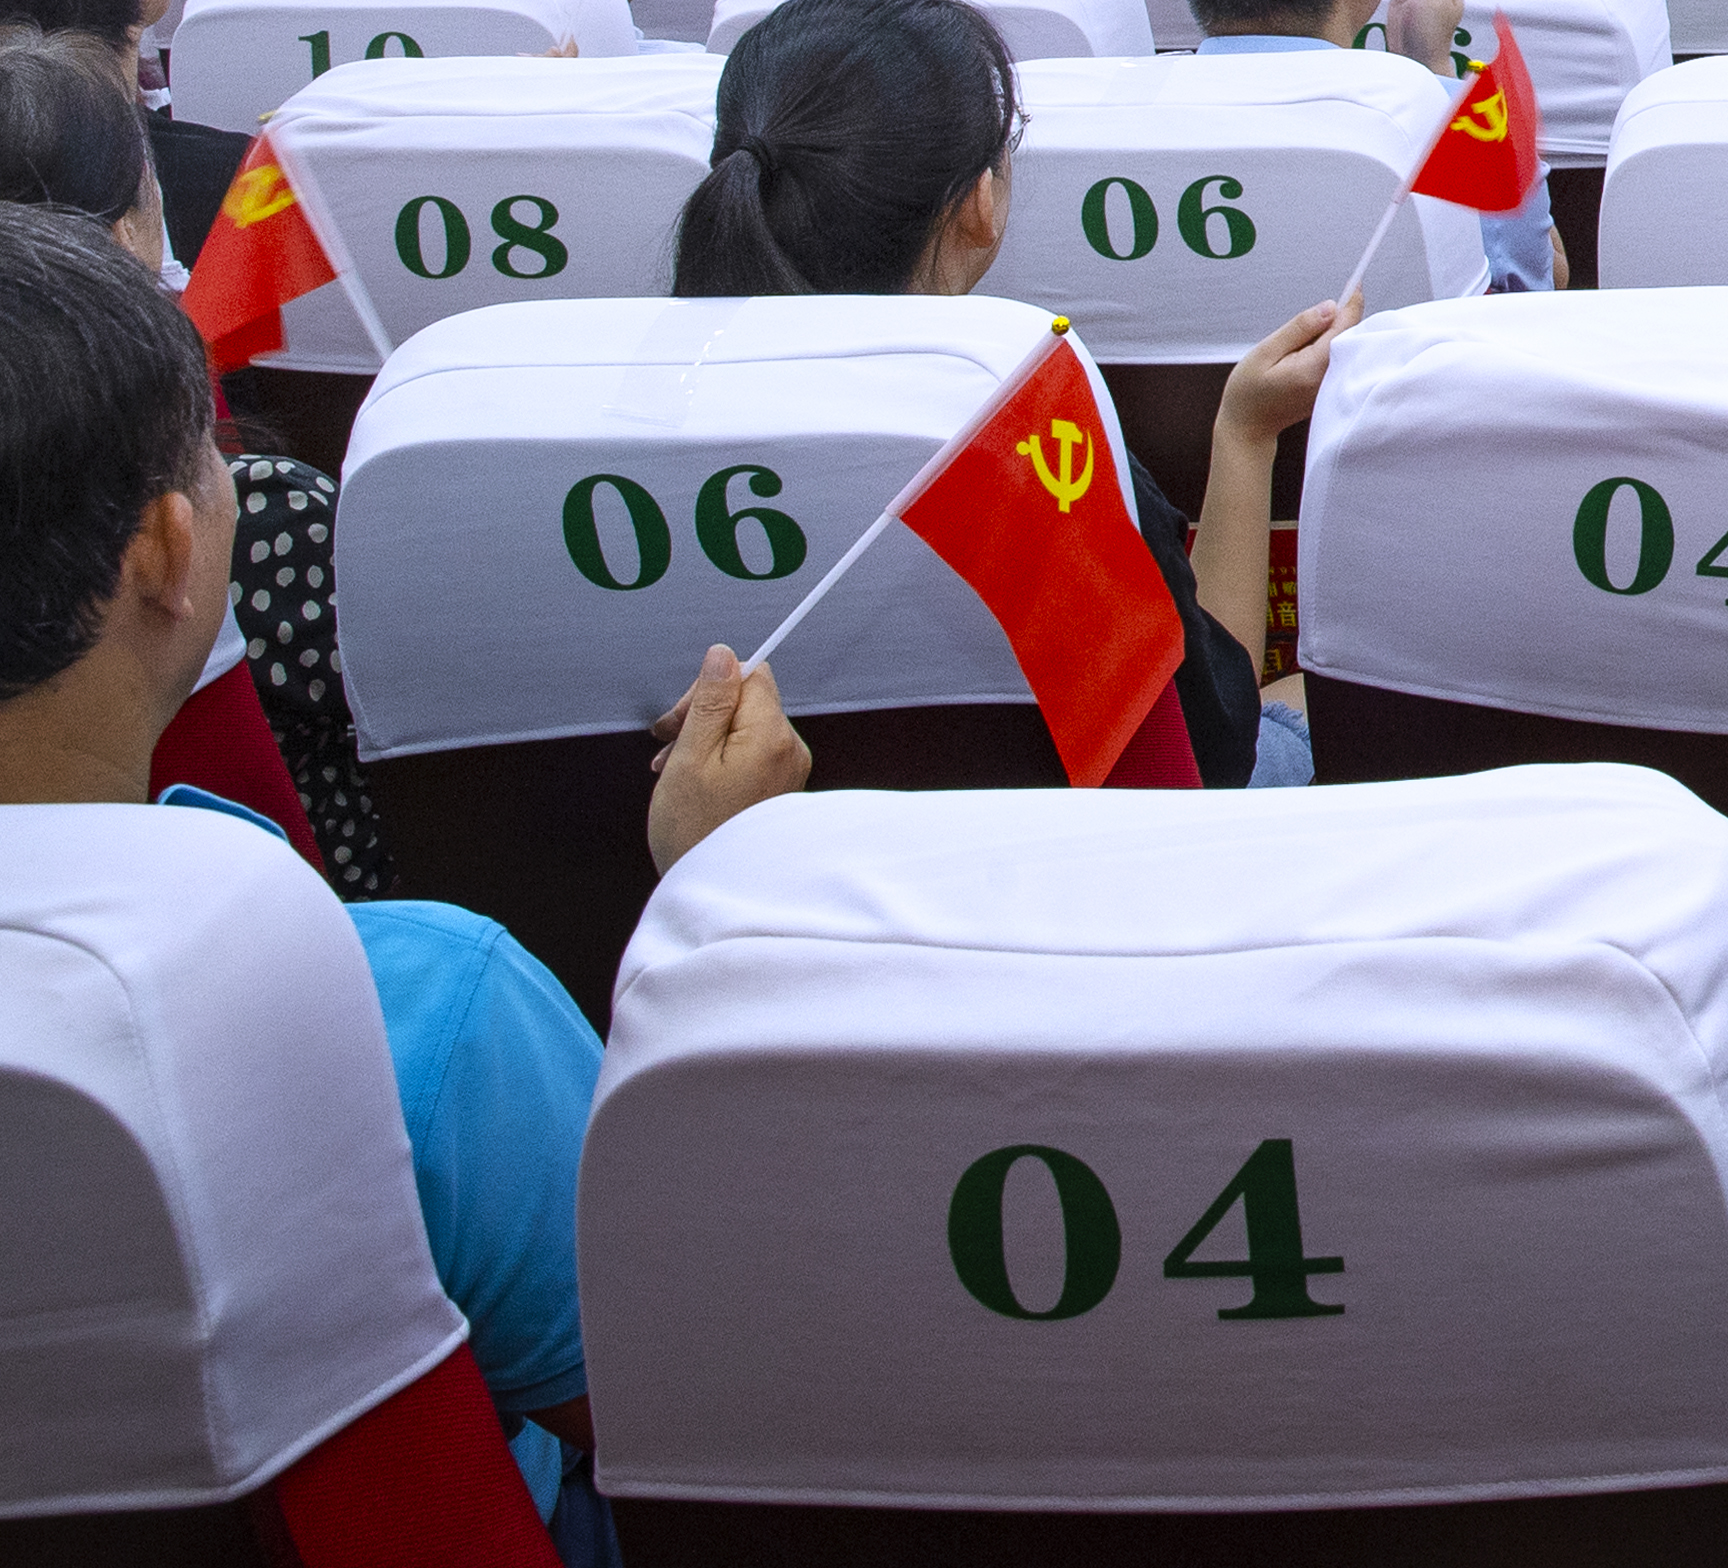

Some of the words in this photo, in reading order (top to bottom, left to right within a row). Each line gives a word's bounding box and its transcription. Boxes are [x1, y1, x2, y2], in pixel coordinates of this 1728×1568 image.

[395, 195, 568, 279] 08
[1080, 175, 1257, 261] 06
[561, 464, 807, 592] 06
[947, 1138, 1346, 1321] 04
